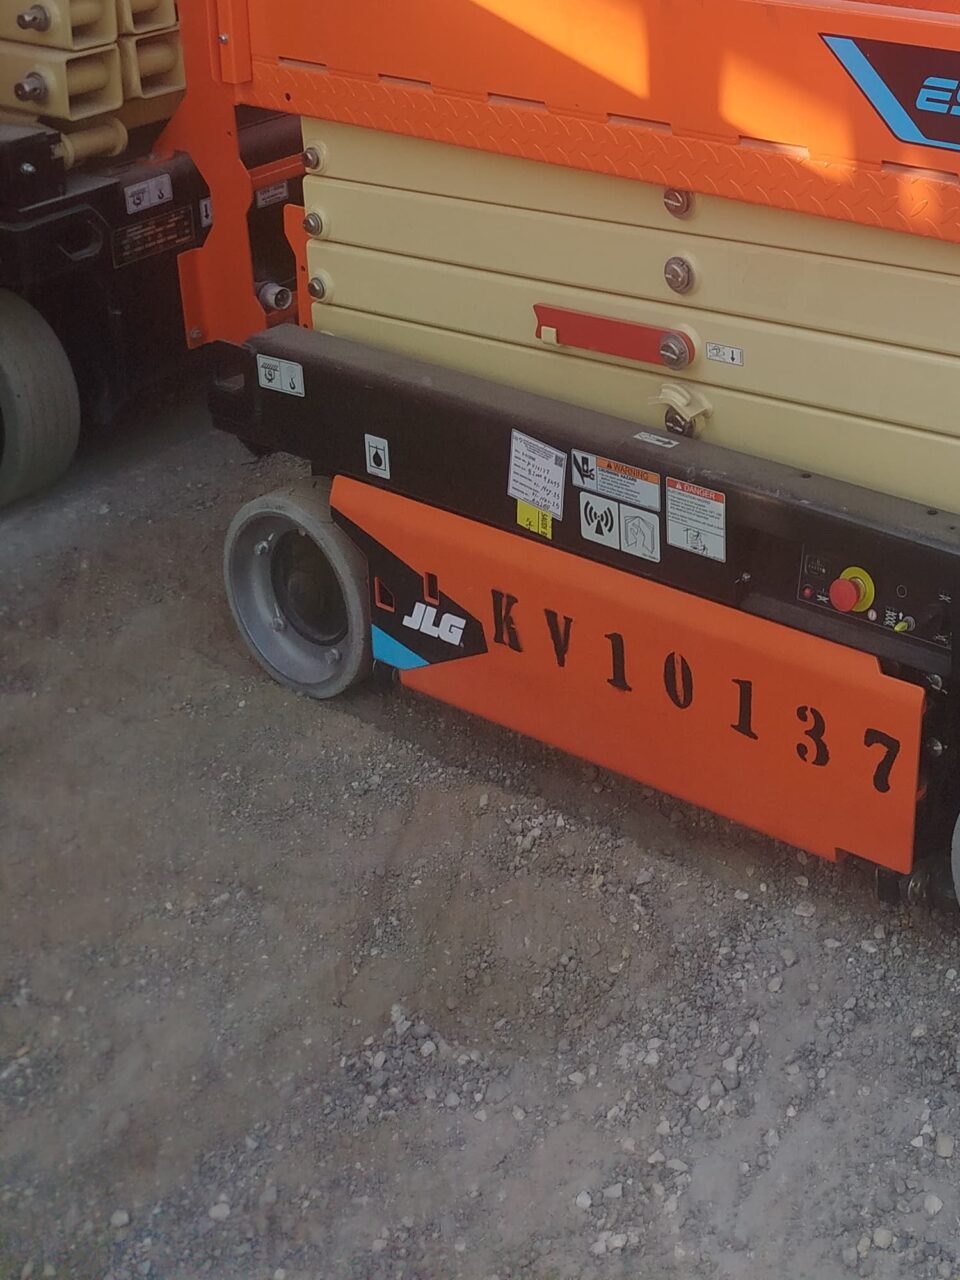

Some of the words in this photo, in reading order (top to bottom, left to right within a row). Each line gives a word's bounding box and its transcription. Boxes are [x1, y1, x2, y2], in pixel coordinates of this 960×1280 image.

[612, 465, 649, 480] WARNING
[684, 485, 716, 500] DANGER
[402, 601, 466, 647] JLG
